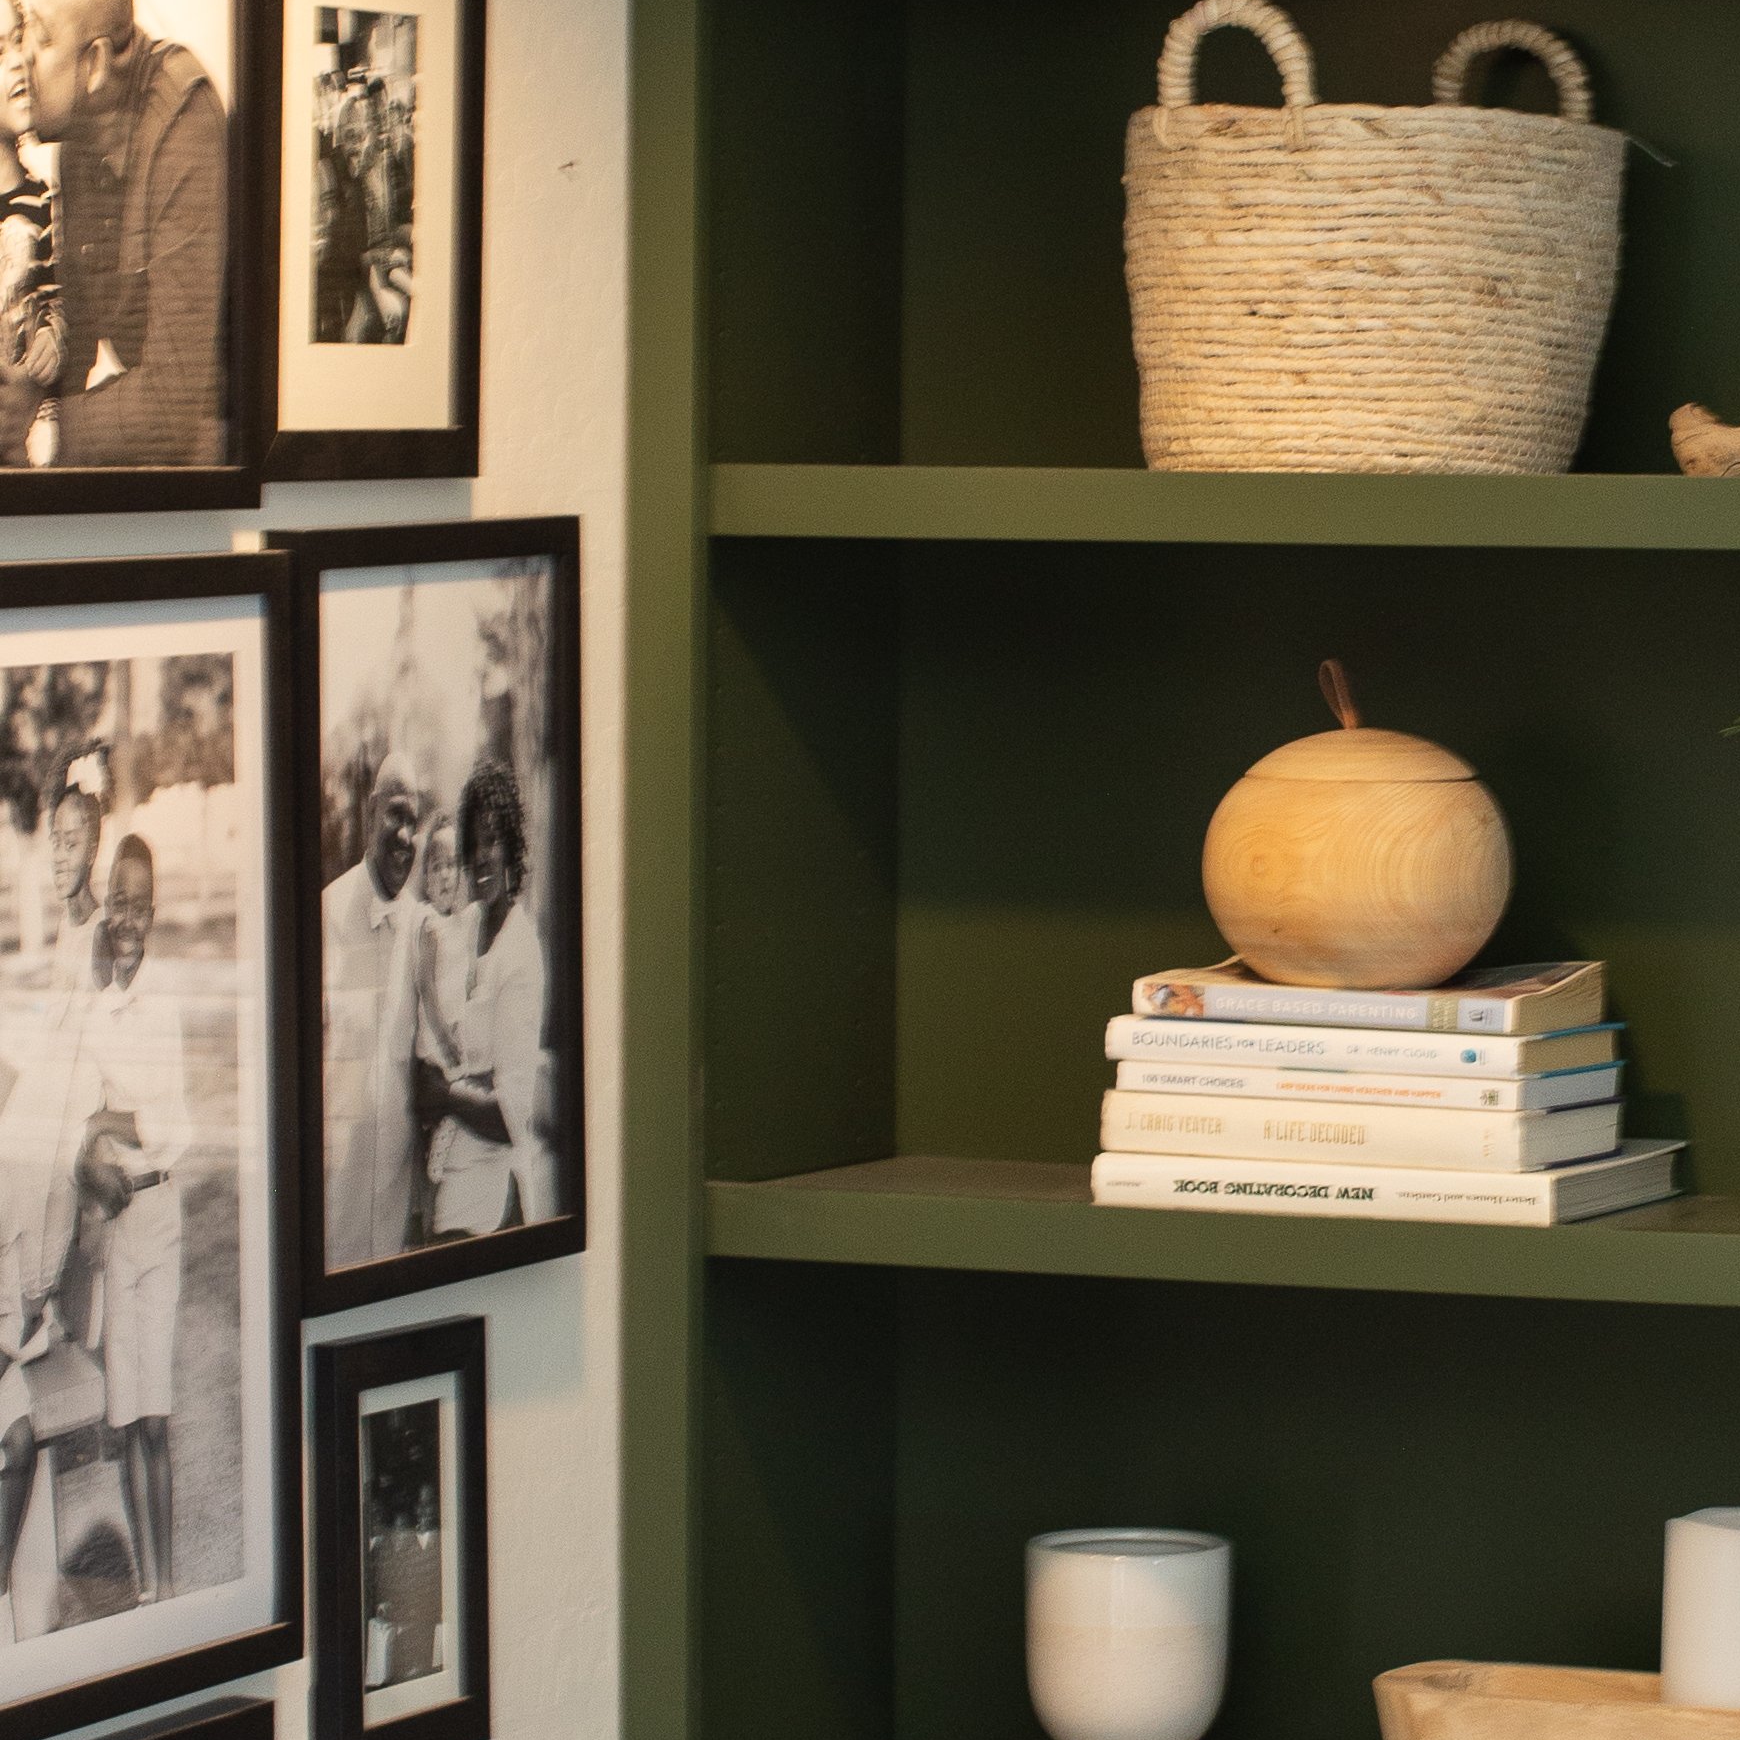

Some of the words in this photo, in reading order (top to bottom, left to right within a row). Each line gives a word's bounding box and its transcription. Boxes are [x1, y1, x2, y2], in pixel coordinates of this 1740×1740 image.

[1215, 996, 1268, 1012] GRACE
[1272, 1000, 1322, 1015] BASED
[1328, 1003, 1417, 1020] PARENTING
[1132, 1031, 1233, 1050] BOUNDARIES
[1258, 1037, 1326, 1055] LEADERS
[1367, 1046, 1399, 1057] HENRY
[1402, 1047, 1438, 1059] CLOUD
[1142, 1073, 1157, 1084] 100
[1160, 1075, 1197, 1086] SMART
[1200, 1077, 1245, 1089] CHOICES
[1139, 1113, 1174, 1132] CRAIG
[1276, 1120, 1306, 1142] LIFE
[1309, 1122, 1368, 1145] DECODED
[1173, 1179, 1220, 1195] BOOK
[1224, 1181, 1330, 1199] DECORATING
[1335, 1186, 1374, 1201] NEW
